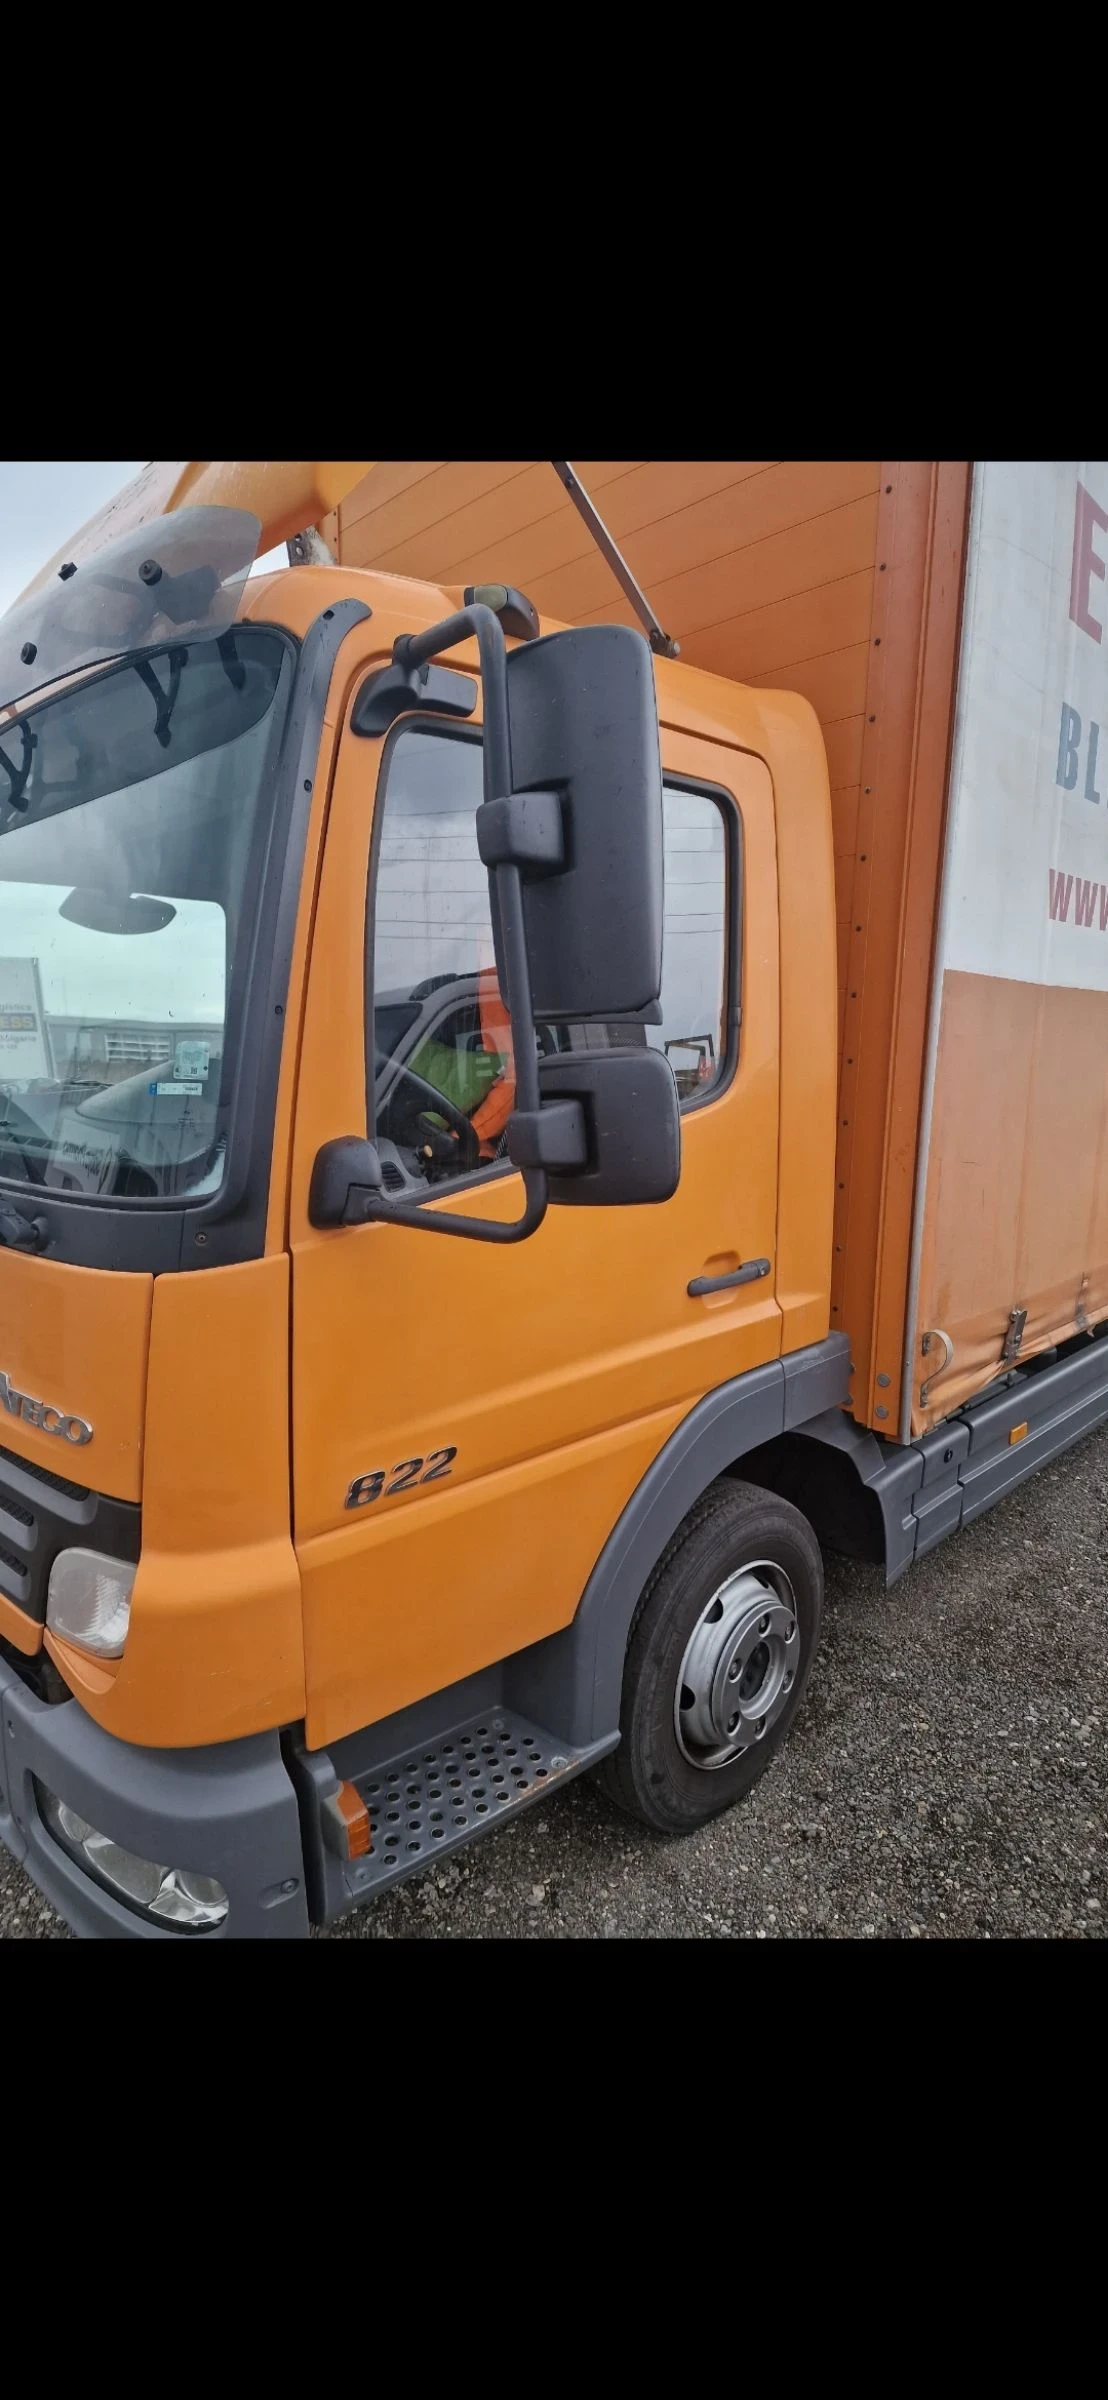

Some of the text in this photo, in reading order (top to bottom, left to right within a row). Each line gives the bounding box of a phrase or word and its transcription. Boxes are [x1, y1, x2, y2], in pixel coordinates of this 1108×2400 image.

[1069, 480, 1108, 645] E
[1055, 701, 1108, 806] BL
[345, 1446, 458, 1509] 822
